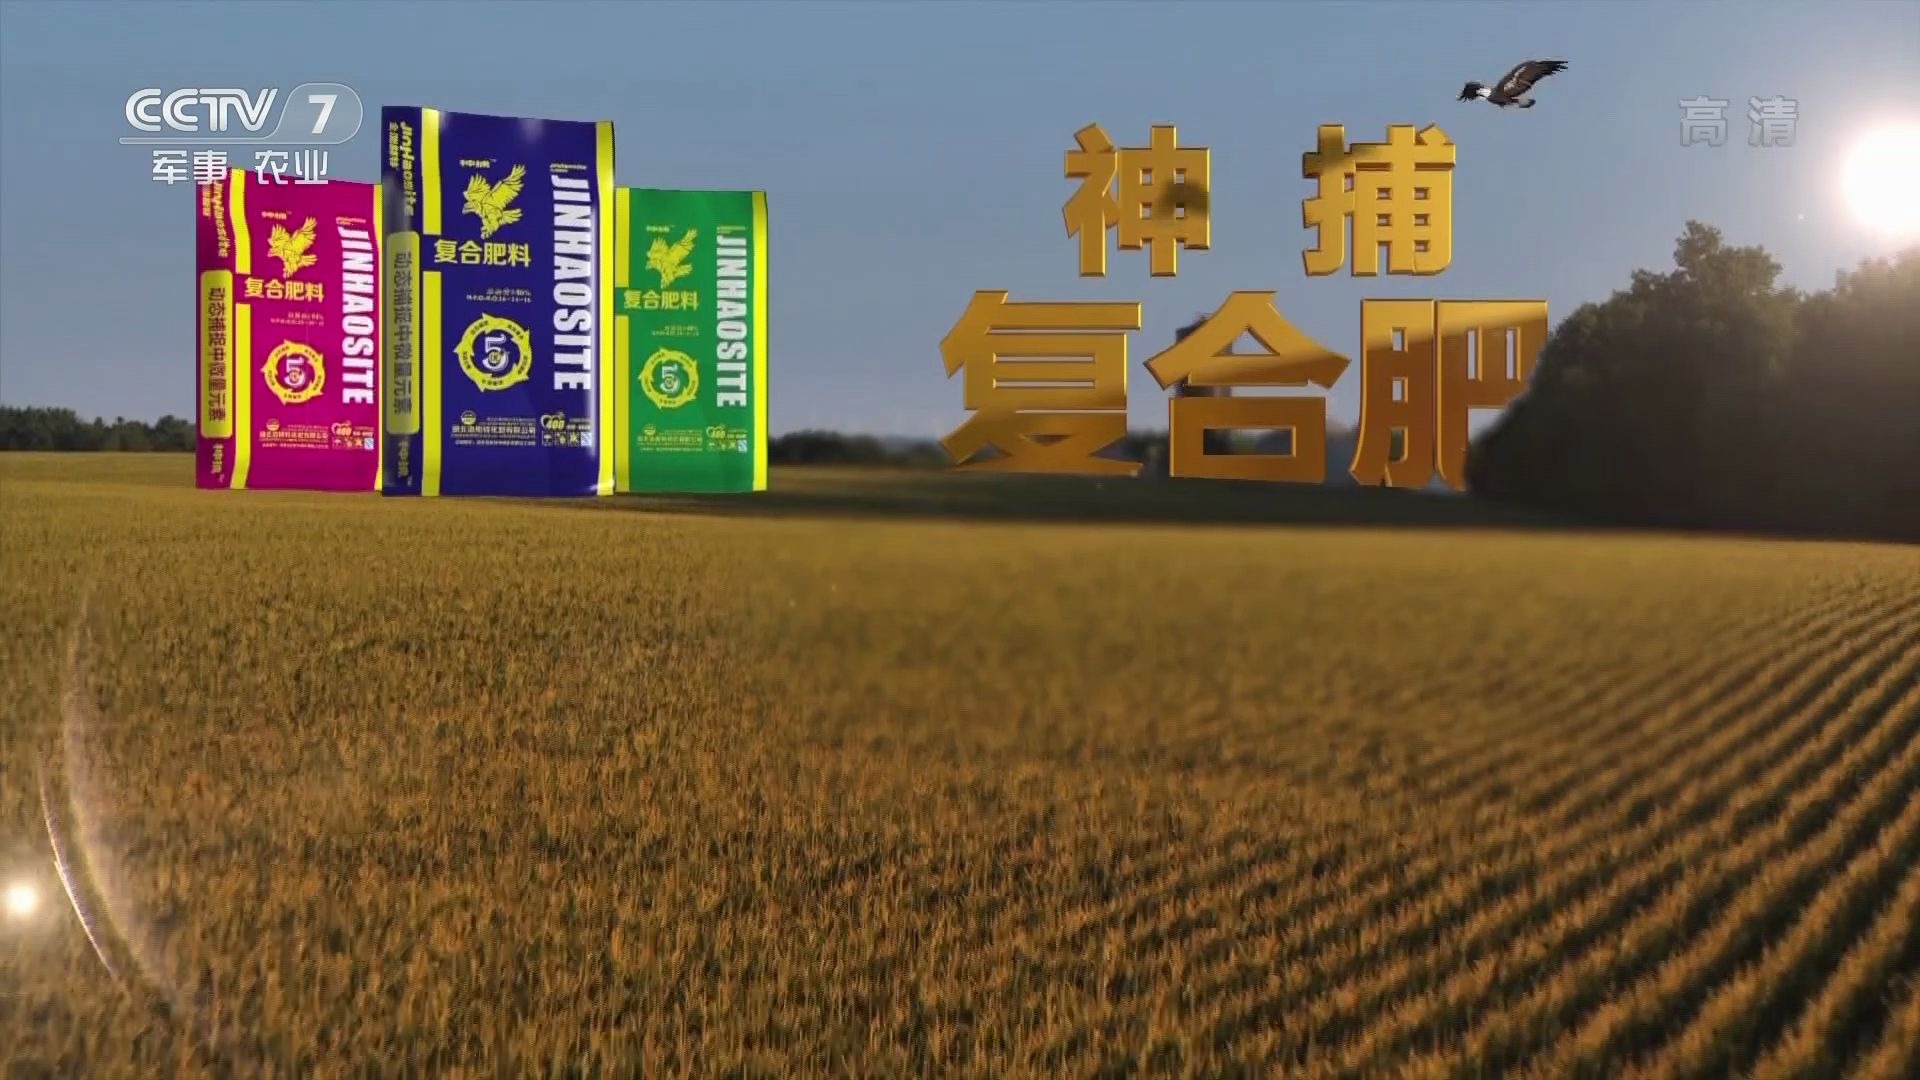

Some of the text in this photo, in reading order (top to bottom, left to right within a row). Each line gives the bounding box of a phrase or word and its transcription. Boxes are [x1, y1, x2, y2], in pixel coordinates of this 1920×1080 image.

[244, 277, 325, 303] 复合肥料
[434, 238, 532, 268] 复合肥料
[551, 175, 593, 391] JINHAOSITE
[623, 290, 699, 311] 复合肥料
[338, 225, 374, 405] JINHAOSITE
[716, 235, 747, 408] JINHAOSITE
